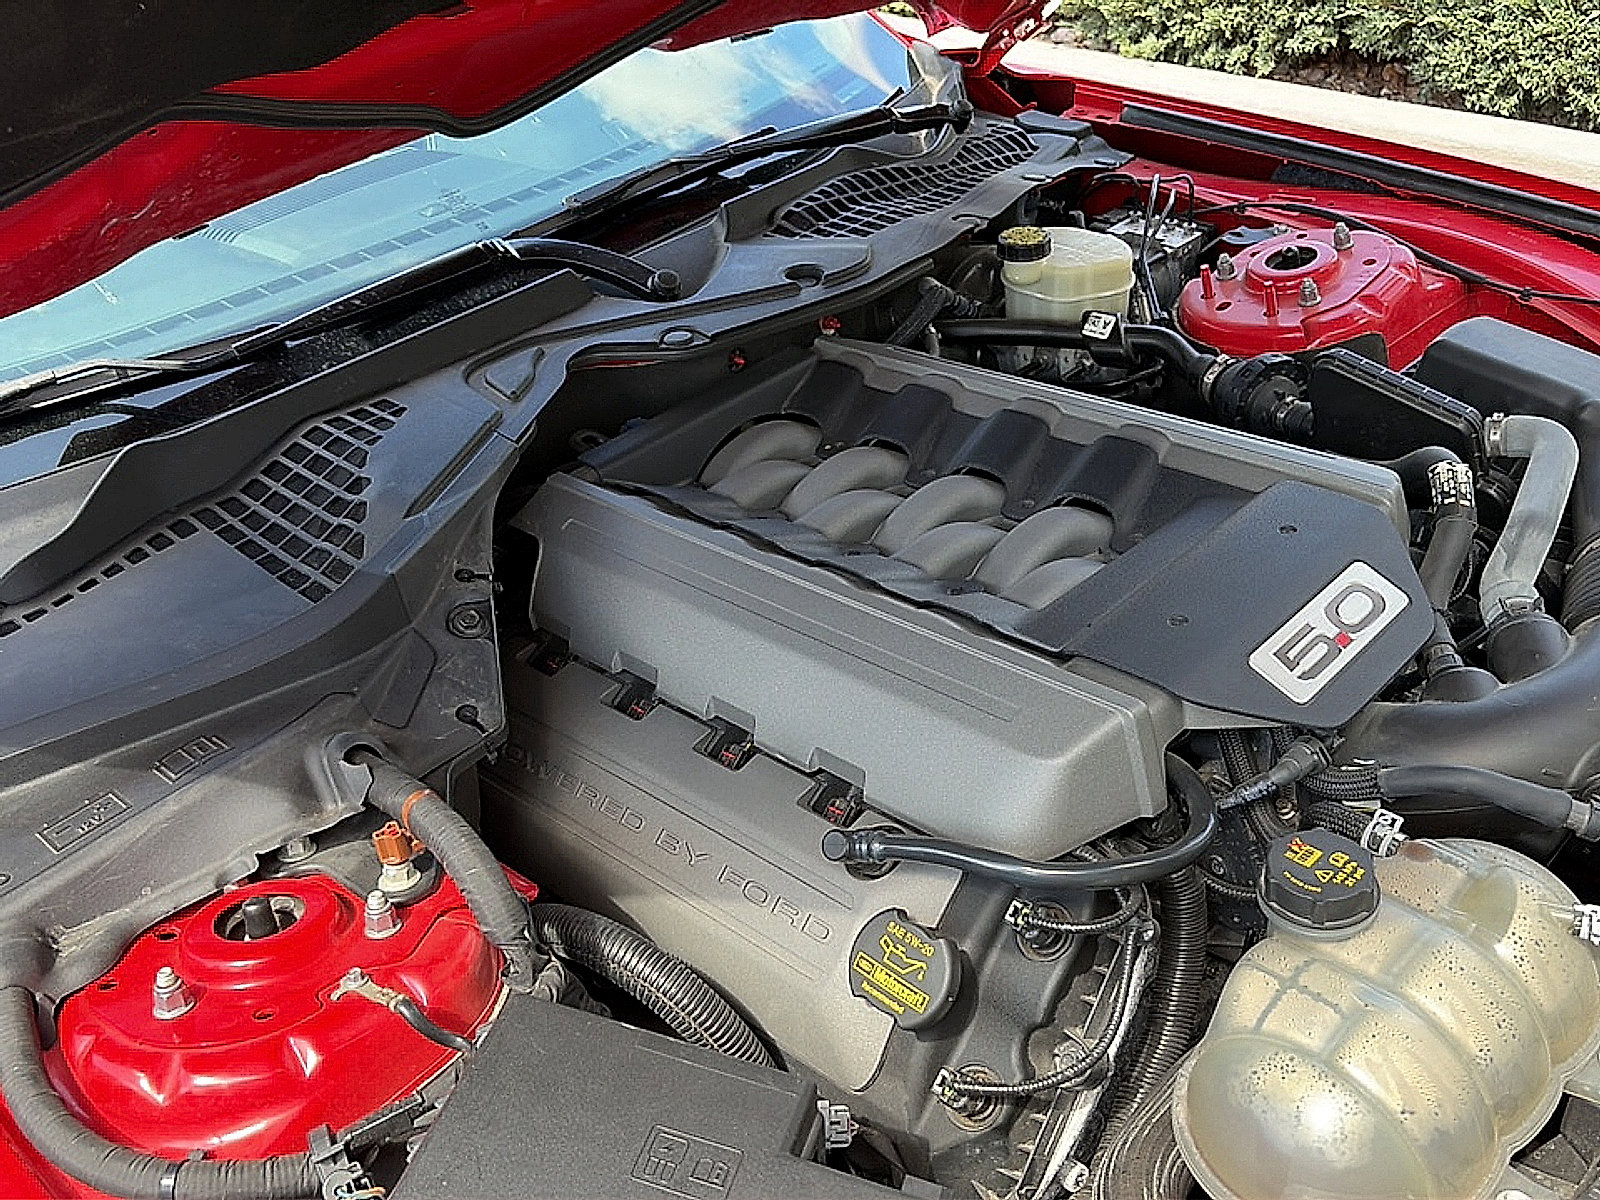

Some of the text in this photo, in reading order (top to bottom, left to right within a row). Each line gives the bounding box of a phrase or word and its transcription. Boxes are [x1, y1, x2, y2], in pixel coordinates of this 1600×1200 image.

[1273, 583, 1386, 680] 5.0
[503, 744, 834, 944] OWERED BY FORD
